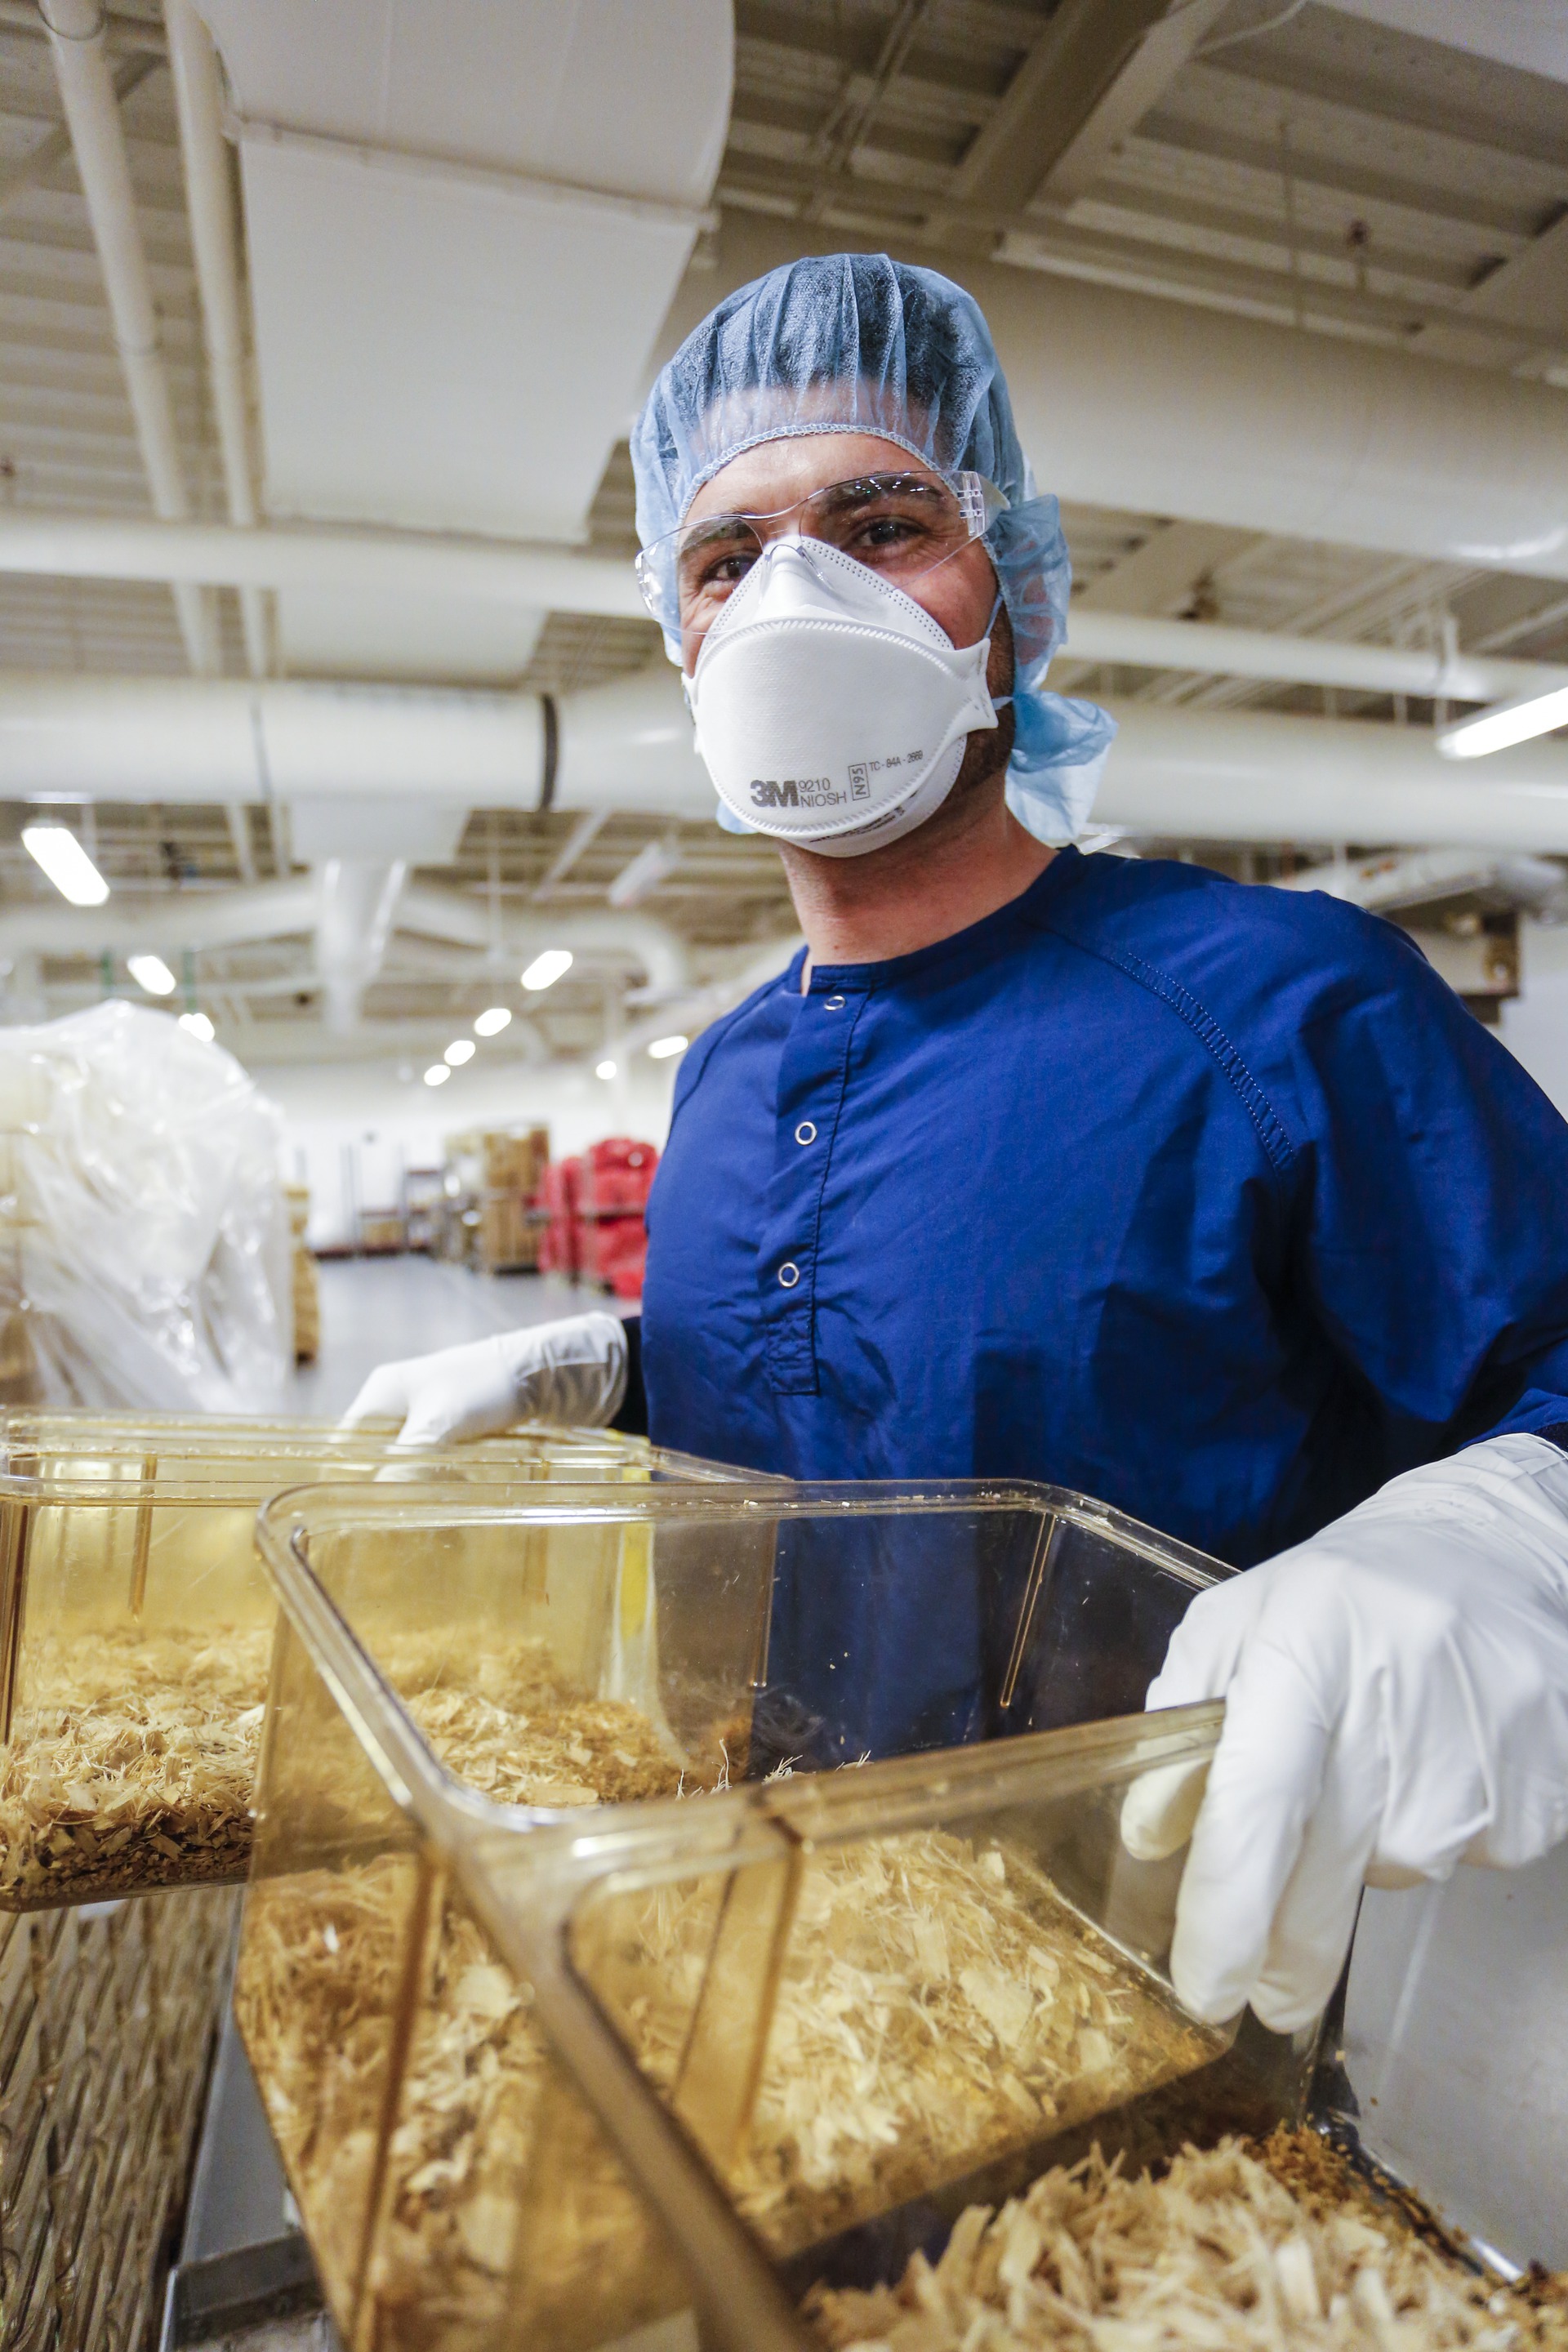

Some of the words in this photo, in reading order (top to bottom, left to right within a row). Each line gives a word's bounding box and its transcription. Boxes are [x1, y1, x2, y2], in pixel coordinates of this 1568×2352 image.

[750, 779, 800, 808] 3M
[798, 777, 831, 793] 9210
[852, 767, 866, 795] N95
[800, 791, 847, 808] NIOSH
